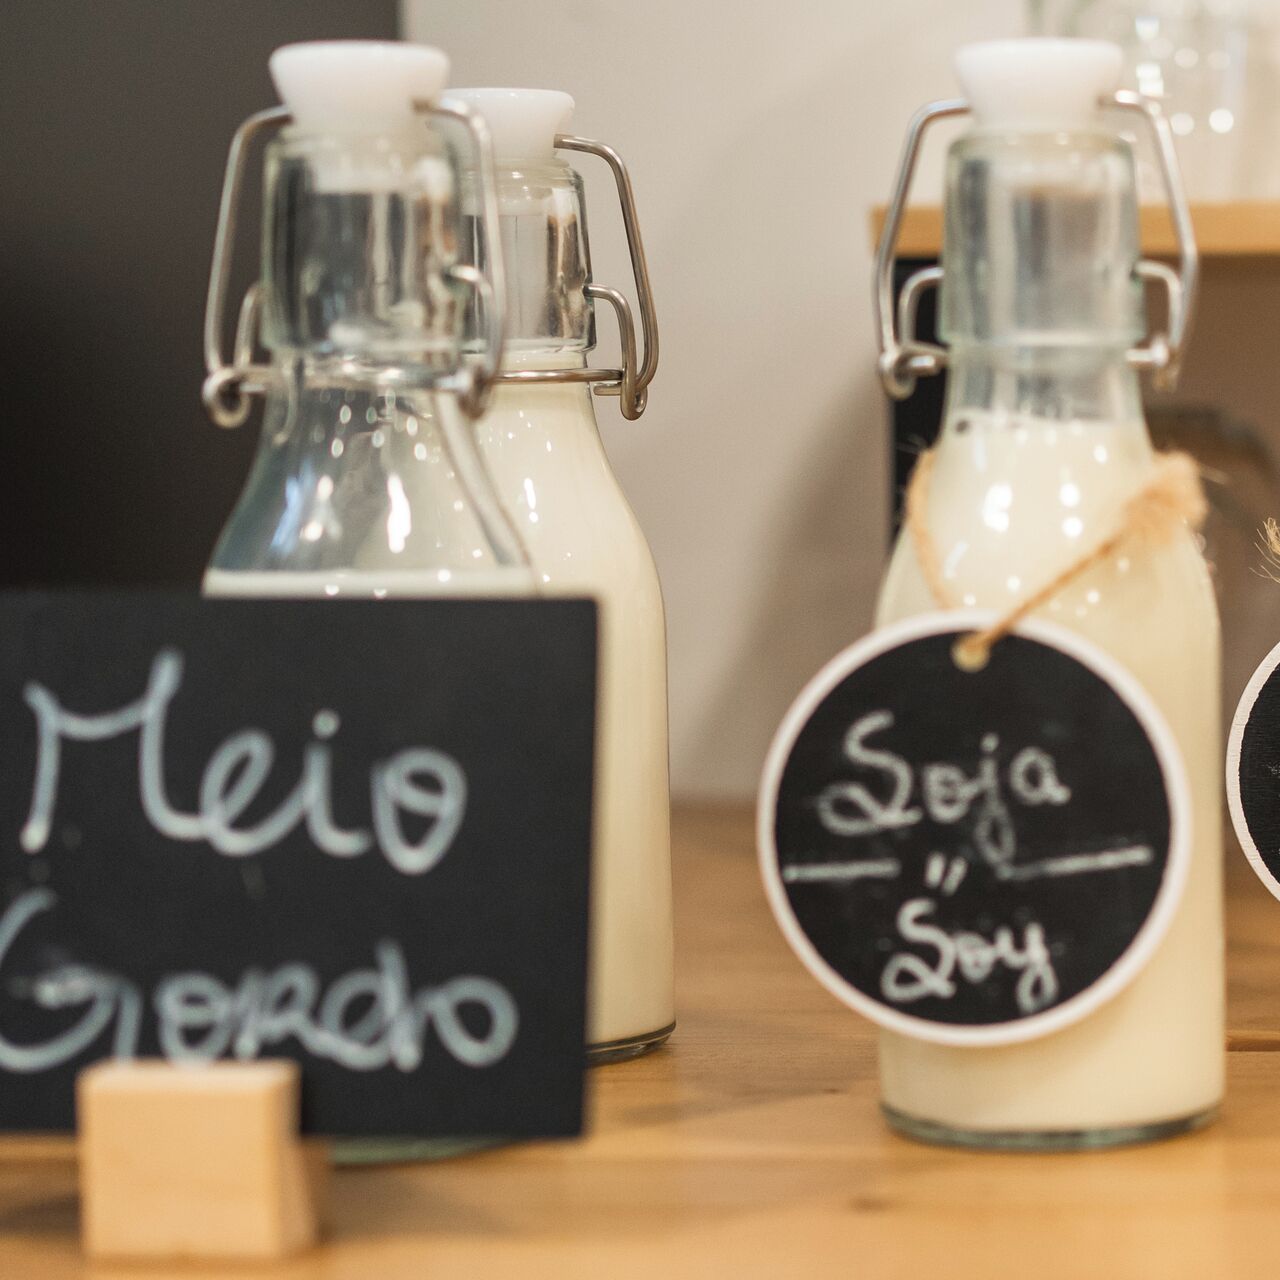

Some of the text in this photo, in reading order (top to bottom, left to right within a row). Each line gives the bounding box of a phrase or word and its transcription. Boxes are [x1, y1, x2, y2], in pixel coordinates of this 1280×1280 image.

[22, 646, 469, 876] Meio
[815, 708, 1074, 878] Soja
[880, 896, 1060, 1015] Soy
